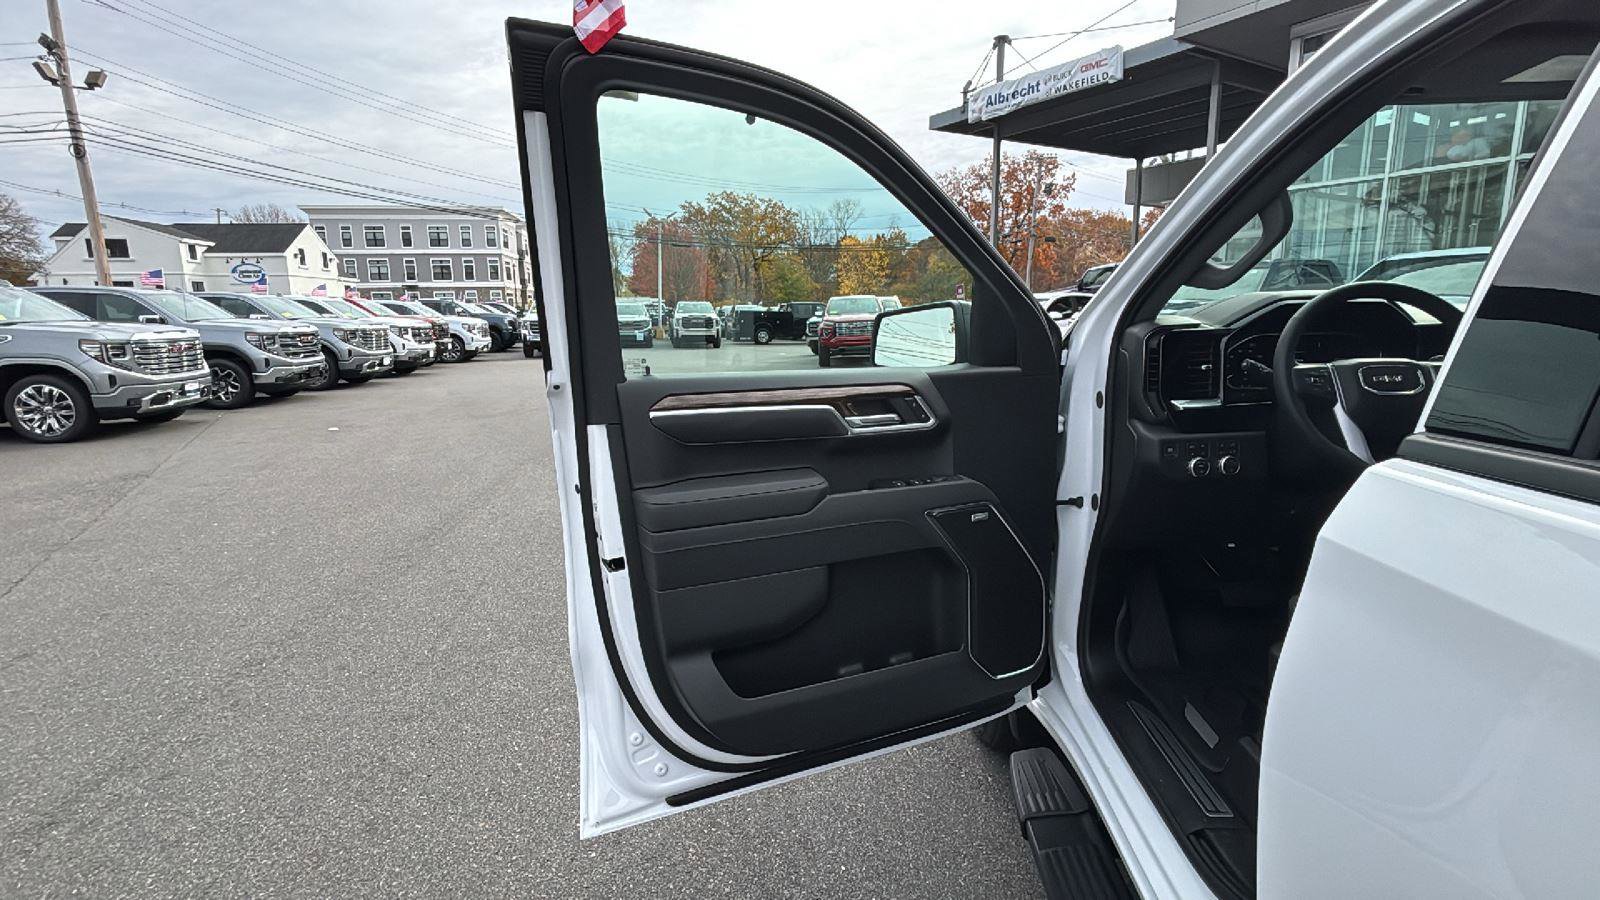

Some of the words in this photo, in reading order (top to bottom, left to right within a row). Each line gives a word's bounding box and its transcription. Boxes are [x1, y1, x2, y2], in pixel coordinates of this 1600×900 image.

[1080, 58, 1108, 74] GMC
[985, 80, 1041, 108] Albrecht
[1054, 72, 1109, 94] WAKEFIELD
